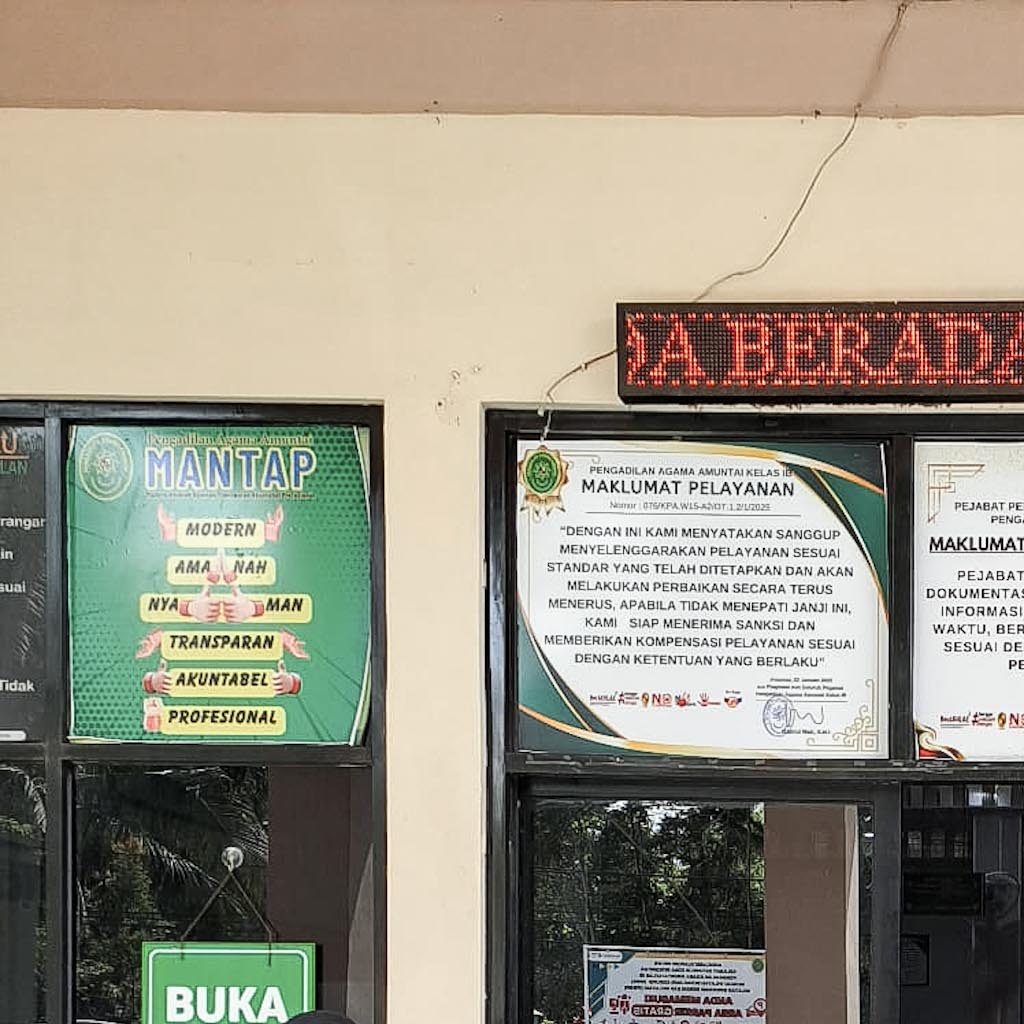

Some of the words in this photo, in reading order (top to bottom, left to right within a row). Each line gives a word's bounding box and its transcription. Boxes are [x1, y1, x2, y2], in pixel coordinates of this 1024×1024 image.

[145, 447, 316, 490] MANTAP
[590, 466, 654, 476] PENGADILAN
[658, 467, 694, 476] AGAMA
[698, 468, 743, 477] AMUNTAI
[746, 468, 779, 477] KELAS
[582, 479, 681, 495] MAKLUMAT
[689, 481, 794, 496] PELAYANAN
[955, 502, 1006, 511] PEJABAT
[186, 523, 256, 537] MODERN
[625, 526, 642, 538] INI
[646, 527, 678, 539] KAMI
[682, 527, 772, 540] MENYATAKAN
[776, 528, 840, 541] SANGGUP
[560, 545, 706, 557] MENYELENGGARAKAN
[710, 547, 789, 558] PELAYANAN
[793, 548, 840, 559] SESUAI
[547, 562, 608, 574] STANDAR
[613, 563, 650, 575] YANG
[654, 564, 696, 576] TELAH
[700, 564, 782, 577] DITETAPKAN
[786, 565, 812, 577] DAN
[817, 566, 853, 578] AKAN
[958, 571, 1024, 581] PEJABAT
[568, 581, 649, 593] MELAKUKAN
[653, 582, 729, 594] PERBAIKAN
[733, 582, 787, 594] SECARA
[791, 583, 833, 595] TERUS
[549, 599, 616, 611] MENERUS,
[620, 600, 676, 612] APABILA
[679, 600, 718, 613] TIDAK
[722, 601, 788, 614] MENEPATI
[792, 602, 828, 614] JANJI
[831, 602, 852, 614] INI,
[941, 606, 1023, 617] INFORMASI
[586, 617, 617, 629] KAMI
[630, 618, 659, 629] SIAP
[663, 618, 732, 630] MENERIMA
[737, 619, 784, 631] SANKSI
[788, 619, 815, 631] DAN
[933, 624, 990, 635] WAKTU,
[169, 636, 274, 649] TRANSPARAN
[545, 635, 632, 647] MEMBERIKAN
[636, 636, 721, 648] KOMPENSASI
[726, 637, 804, 649] PELAYANAN
[808, 638, 855, 650] SESUAI
[944, 642, 997, 652] SESUAI
[575, 654, 629, 666] DENGAN
[634, 654, 713, 666] KETENTUAN
[716, 655, 752, 667] YANG
[176, 673, 269, 687] AKUNTABEL
[168, 710, 278, 724] PROFESIONAL
[166, 986, 288, 1023] BUKA
